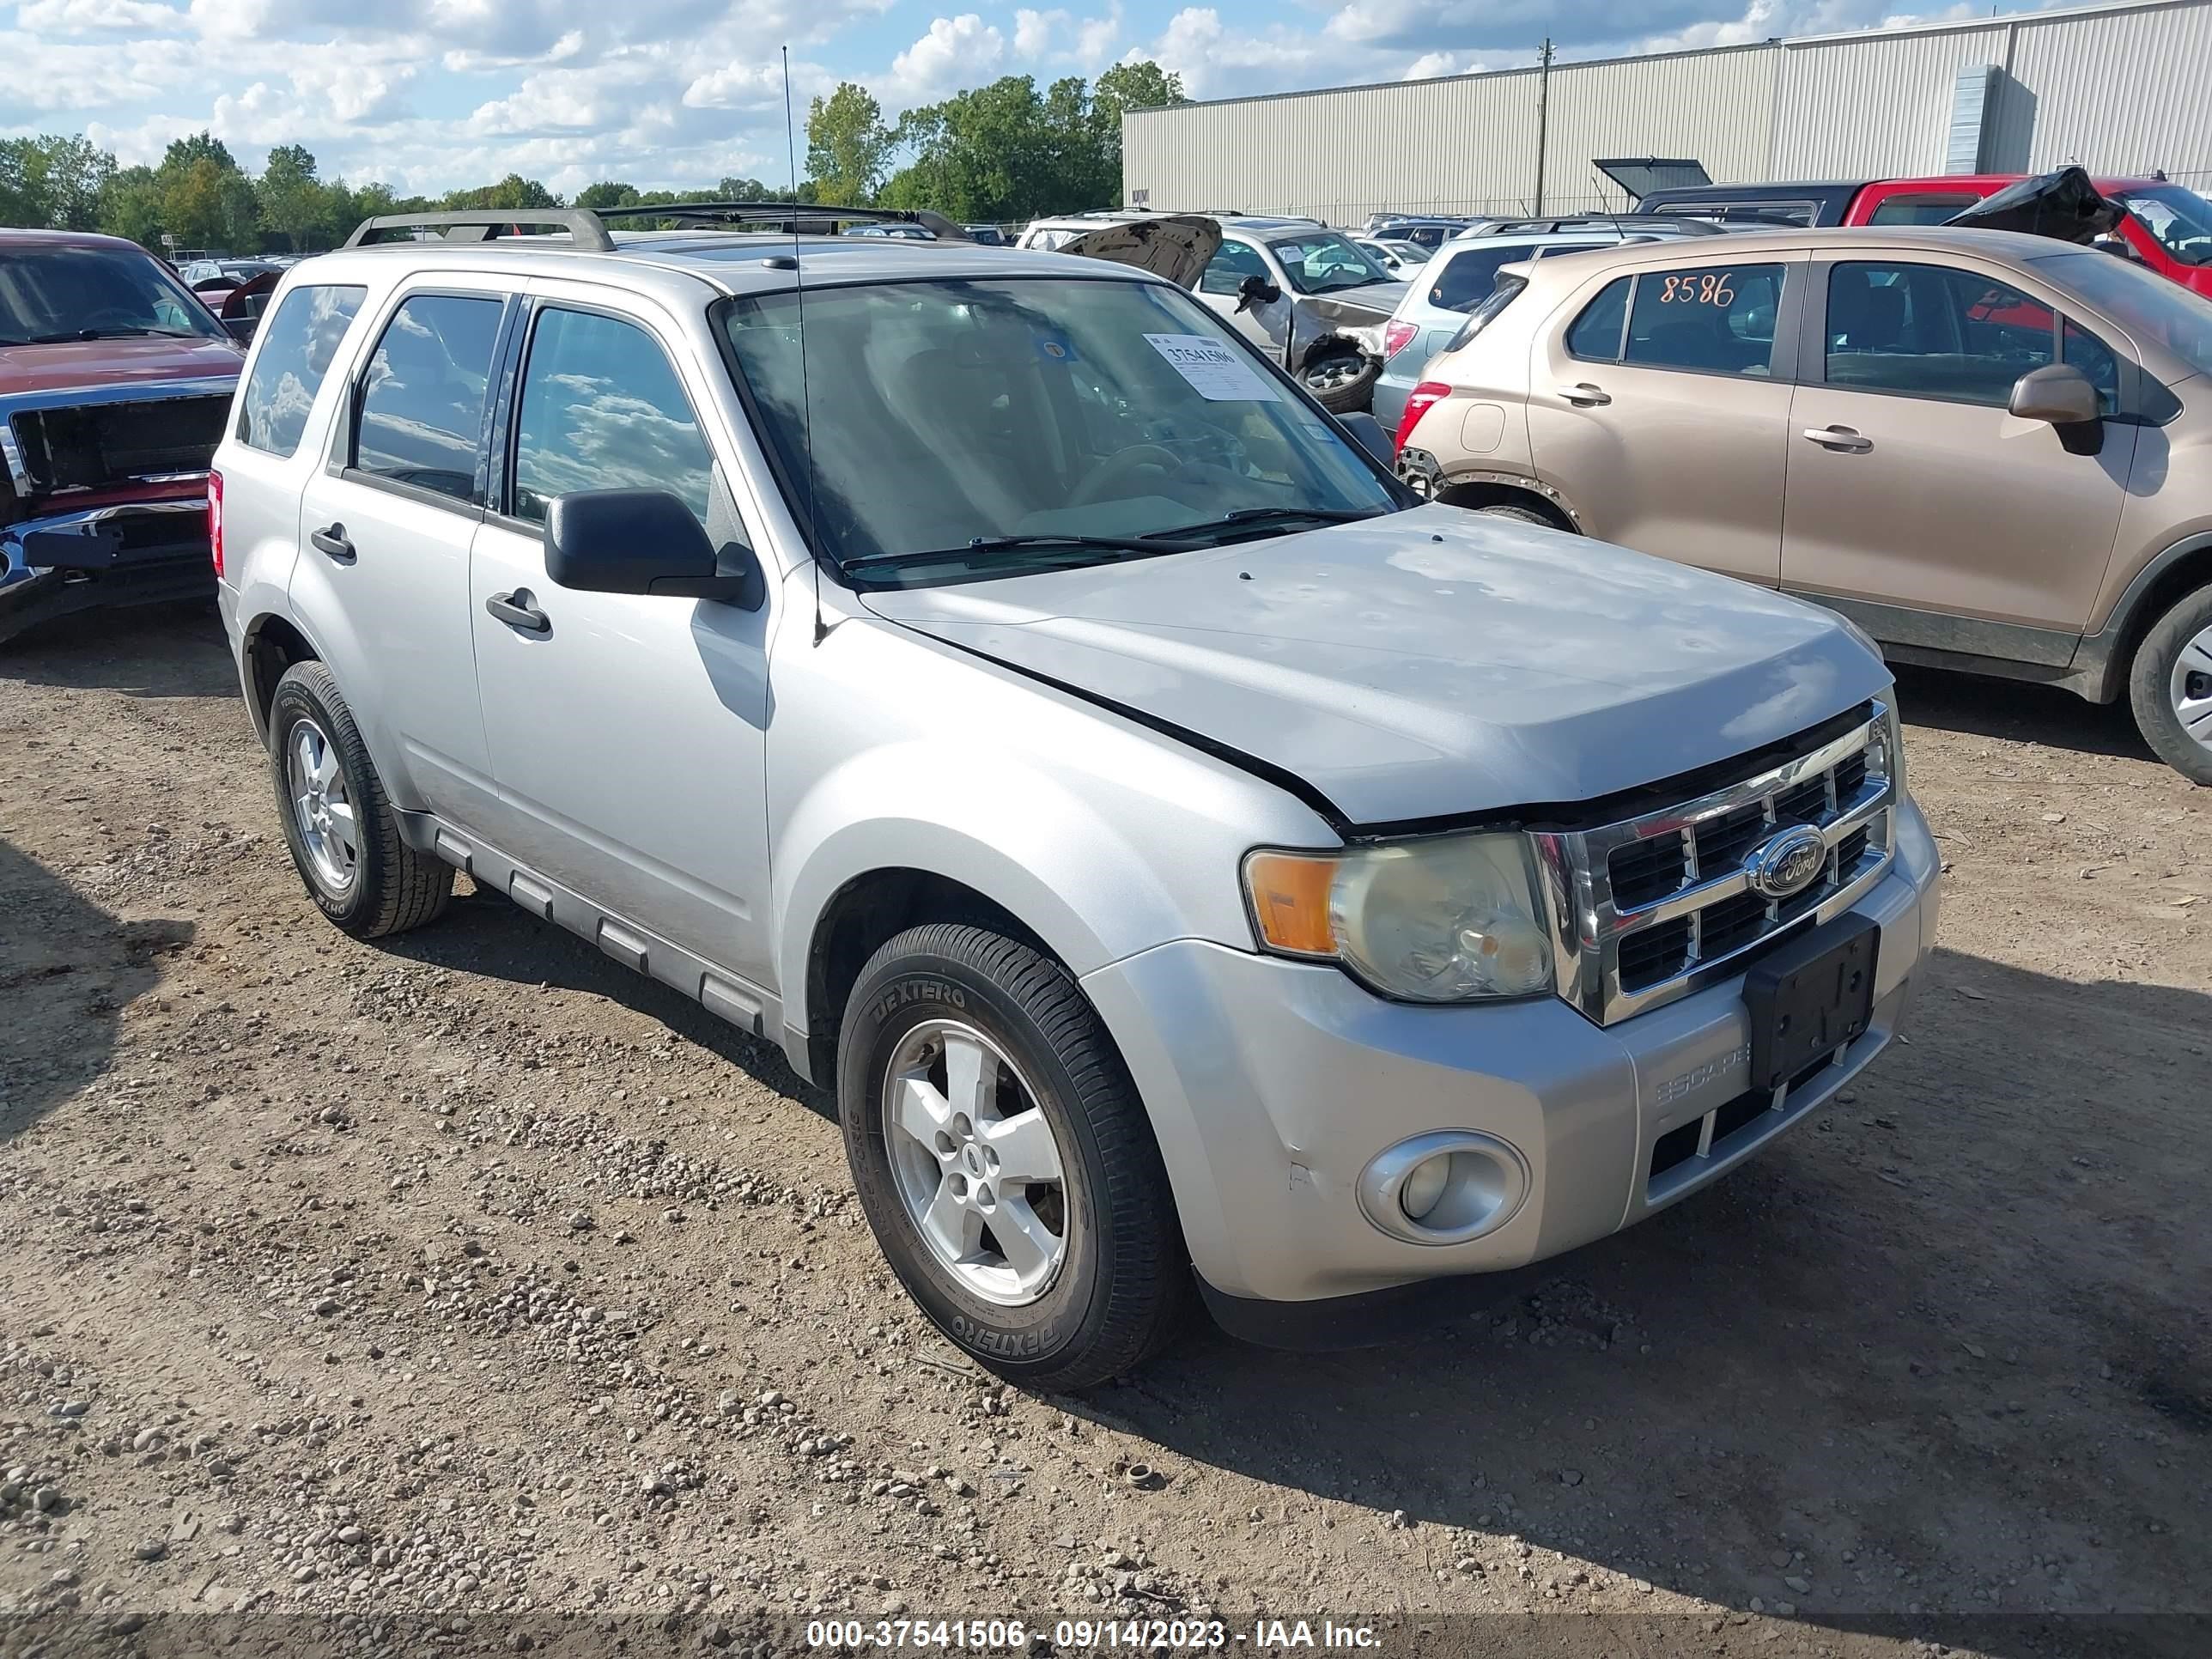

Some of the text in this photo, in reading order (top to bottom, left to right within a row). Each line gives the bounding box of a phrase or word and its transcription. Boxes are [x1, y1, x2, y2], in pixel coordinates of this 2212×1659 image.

[1660, 273, 1735, 307] 8586
[1168, 349, 1236, 364] 37541506
[1785, 846, 1817, 881] Ford
[869, 980, 966, 1024] DEXTERO
[1656, 1042, 1752, 1107] ESCAPE
[951, 1315, 1063, 1358] DEXTERO
